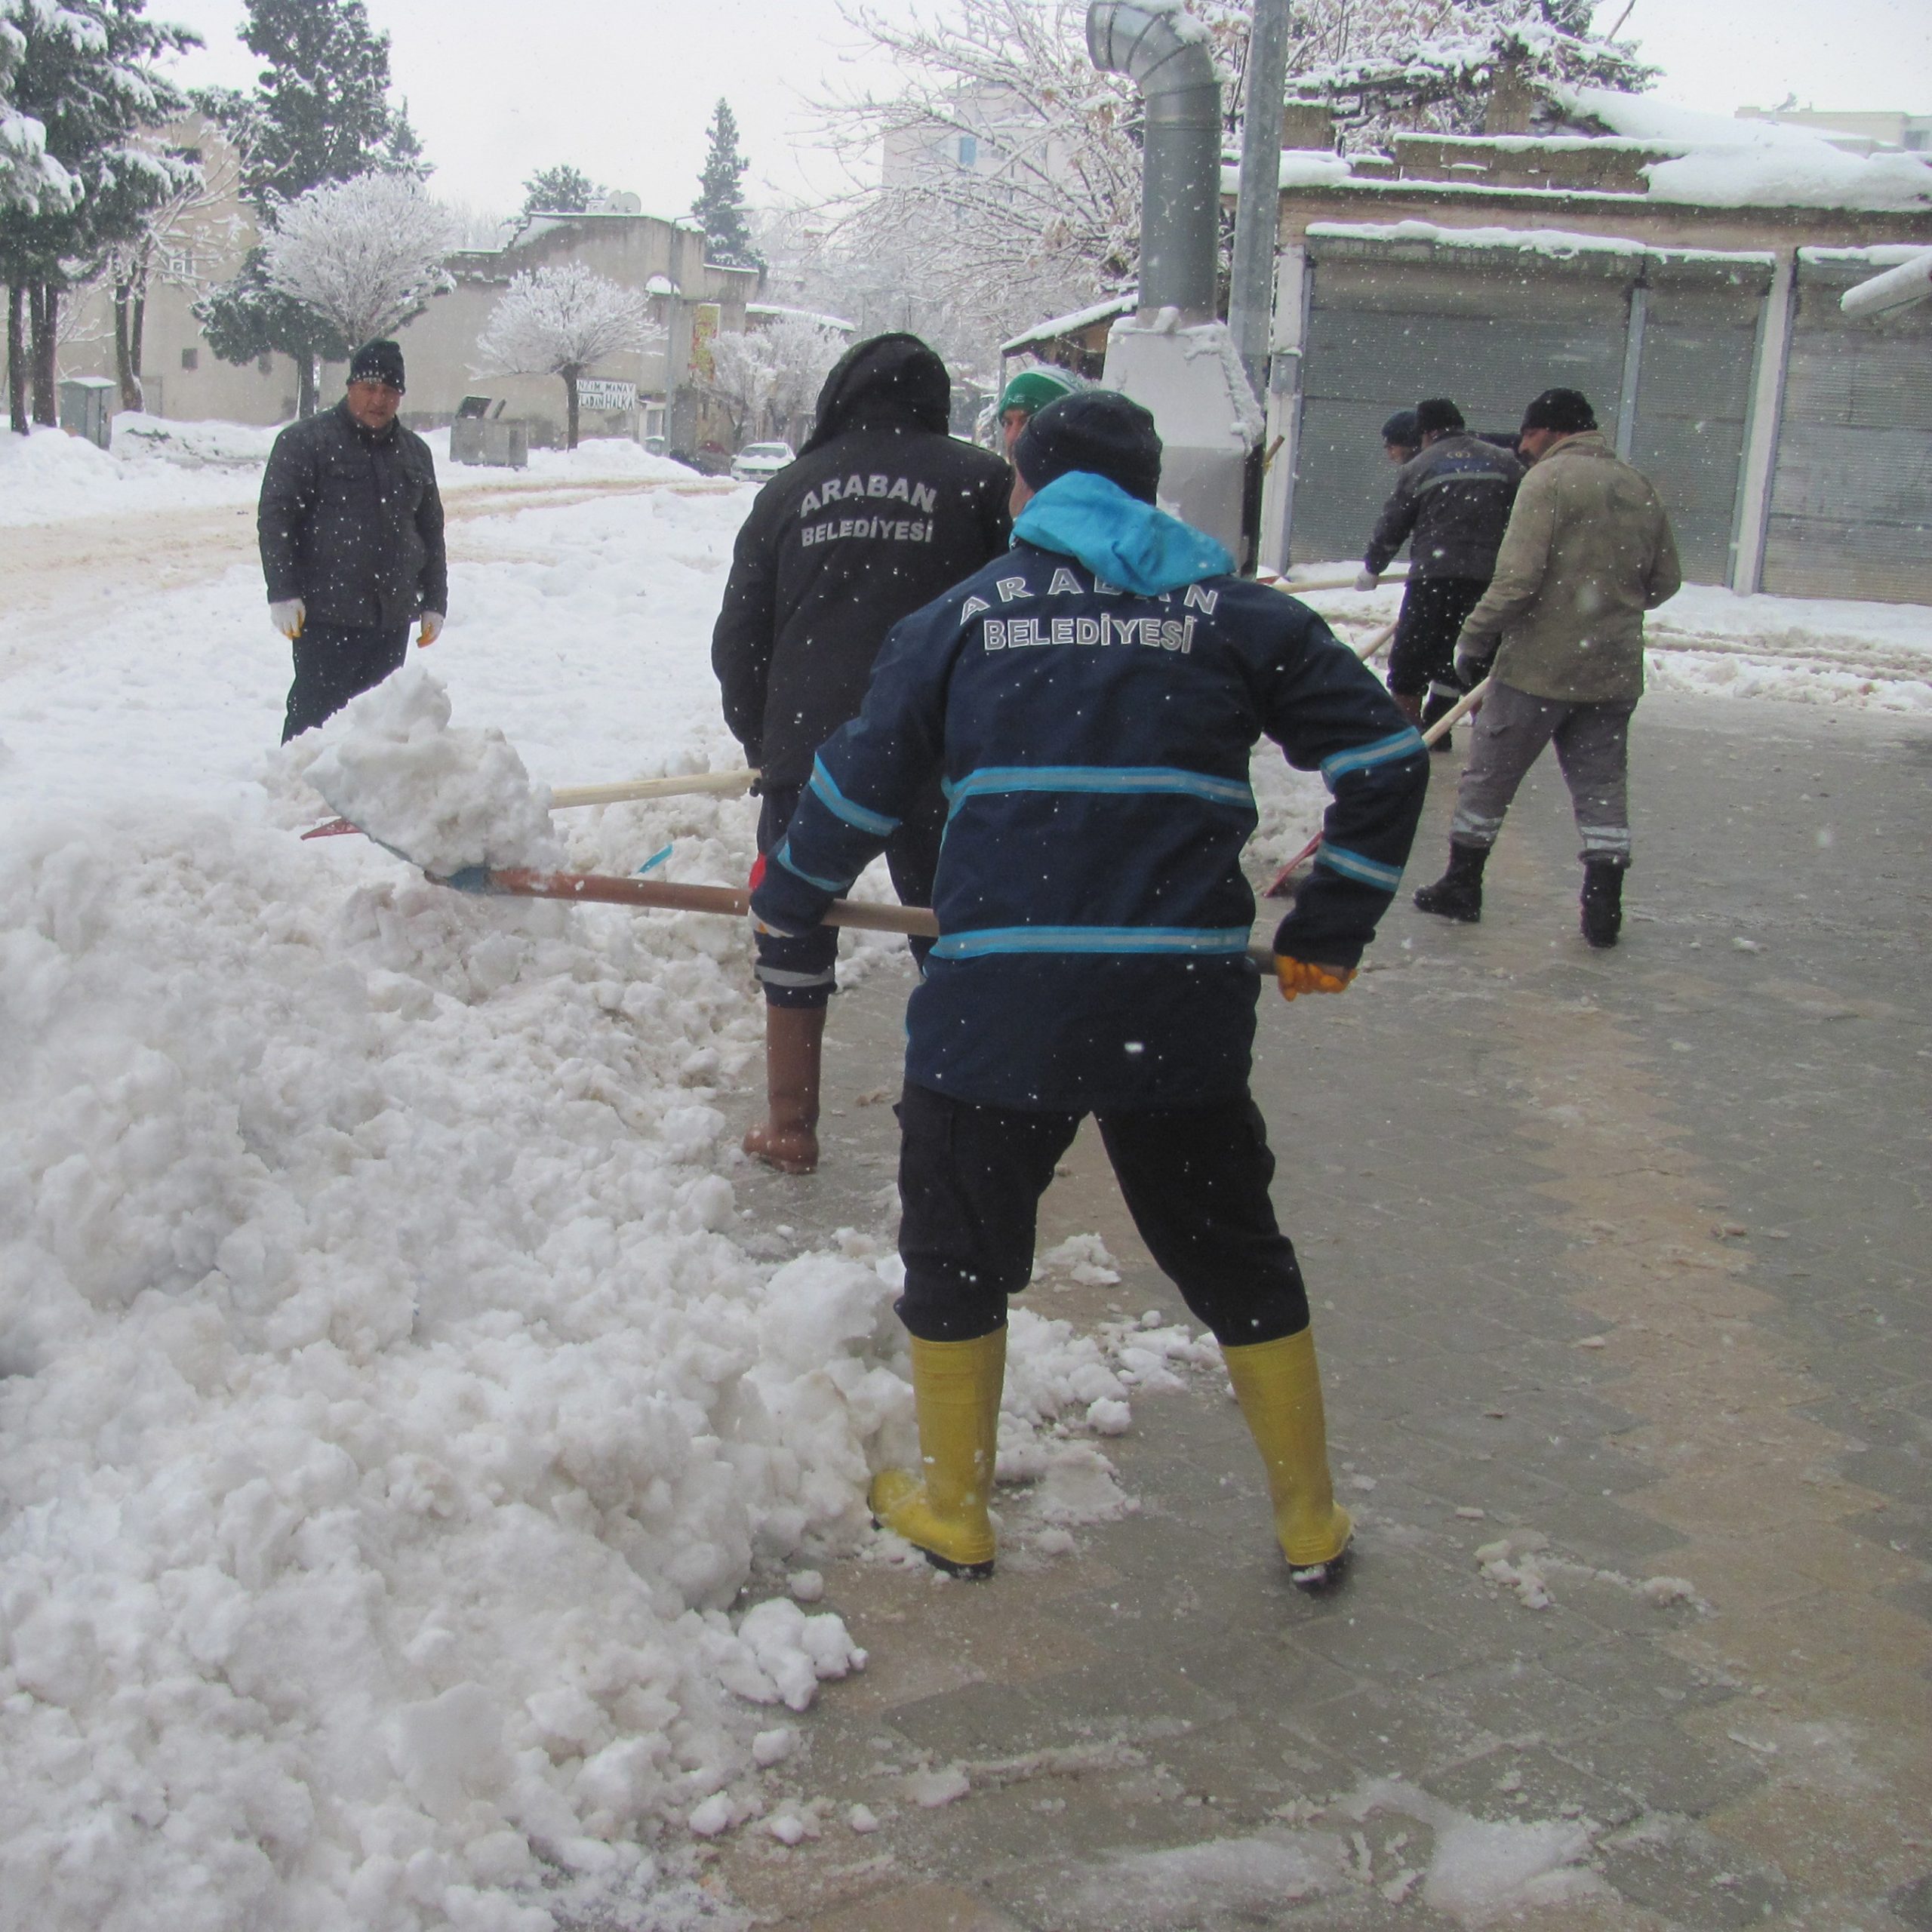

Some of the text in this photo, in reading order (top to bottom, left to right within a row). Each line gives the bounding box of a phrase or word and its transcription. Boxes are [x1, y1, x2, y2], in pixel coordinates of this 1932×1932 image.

[579, 393, 635, 411] LADAN HALKA
[800, 474, 937, 518] ARABAN
[801, 516, 934, 547] BELEDİYESİ
[959, 568, 1219, 626] ARAN
[983, 613, 1195, 654] BELEDİYESİ
